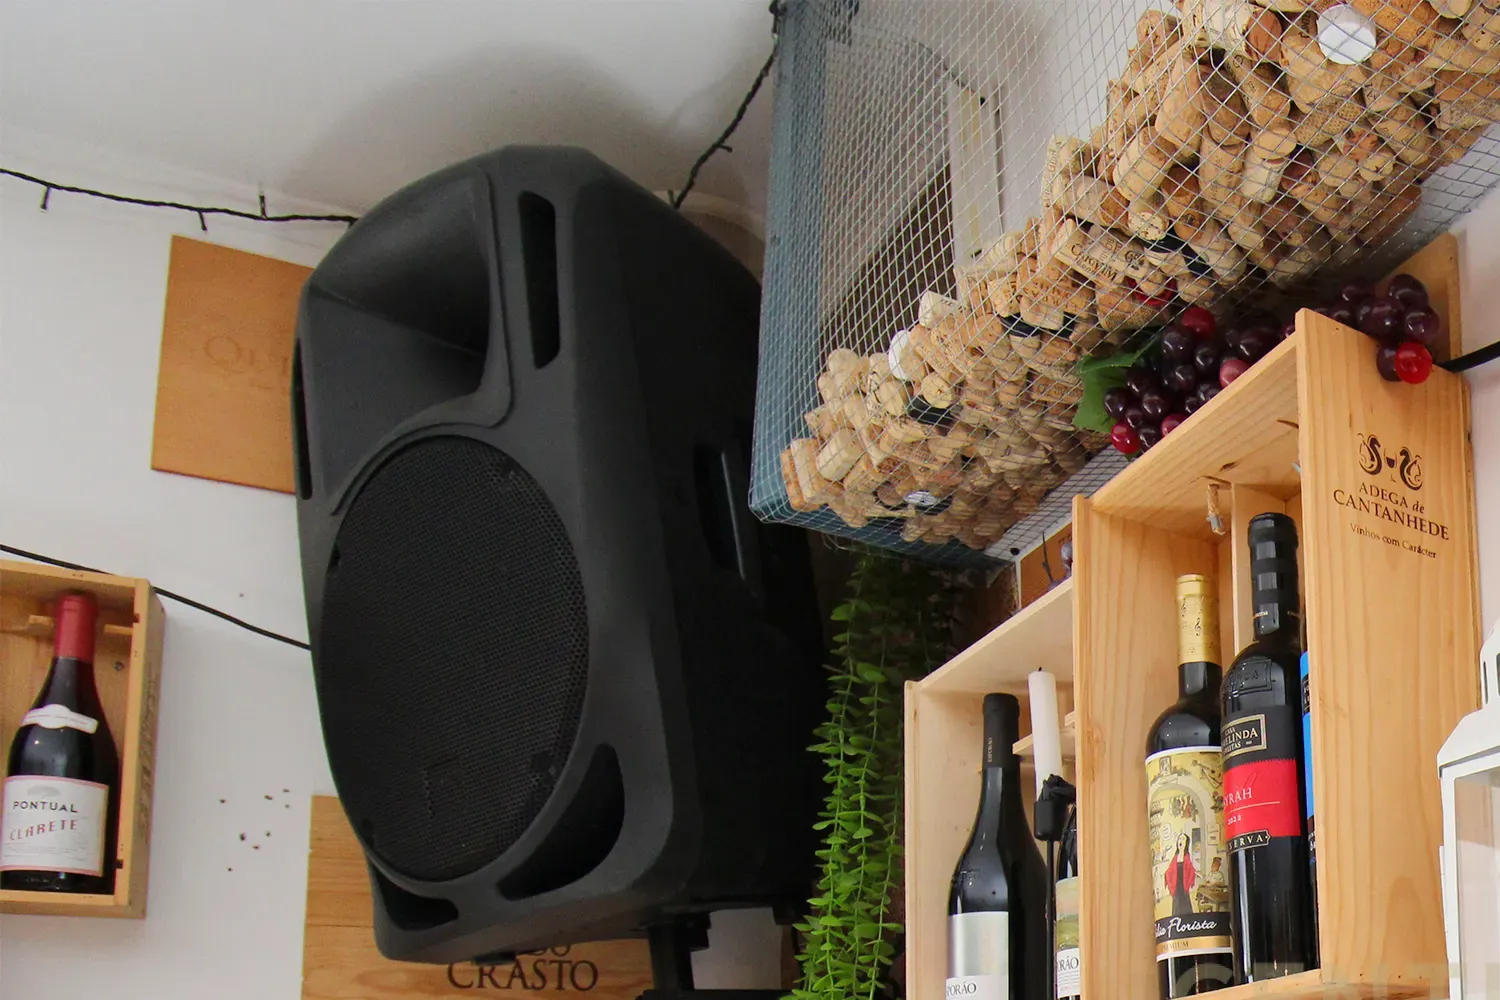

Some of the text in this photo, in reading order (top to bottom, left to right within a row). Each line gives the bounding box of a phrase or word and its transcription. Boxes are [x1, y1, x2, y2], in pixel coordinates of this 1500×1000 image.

[1359, 482, 1424, 514] ADEGA de
[1333, 489, 1449, 540] CANTANHEDE
[1350, 523, 1380, 540] Vinhos
[1382, 535, 1400, 547] com
[13, 801, 78, 813] PONTUAL
[10, 819, 78, 841] CLARETE
[1168, 917, 1218, 939] Florista
[447, 958, 598, 991] CRASTO
